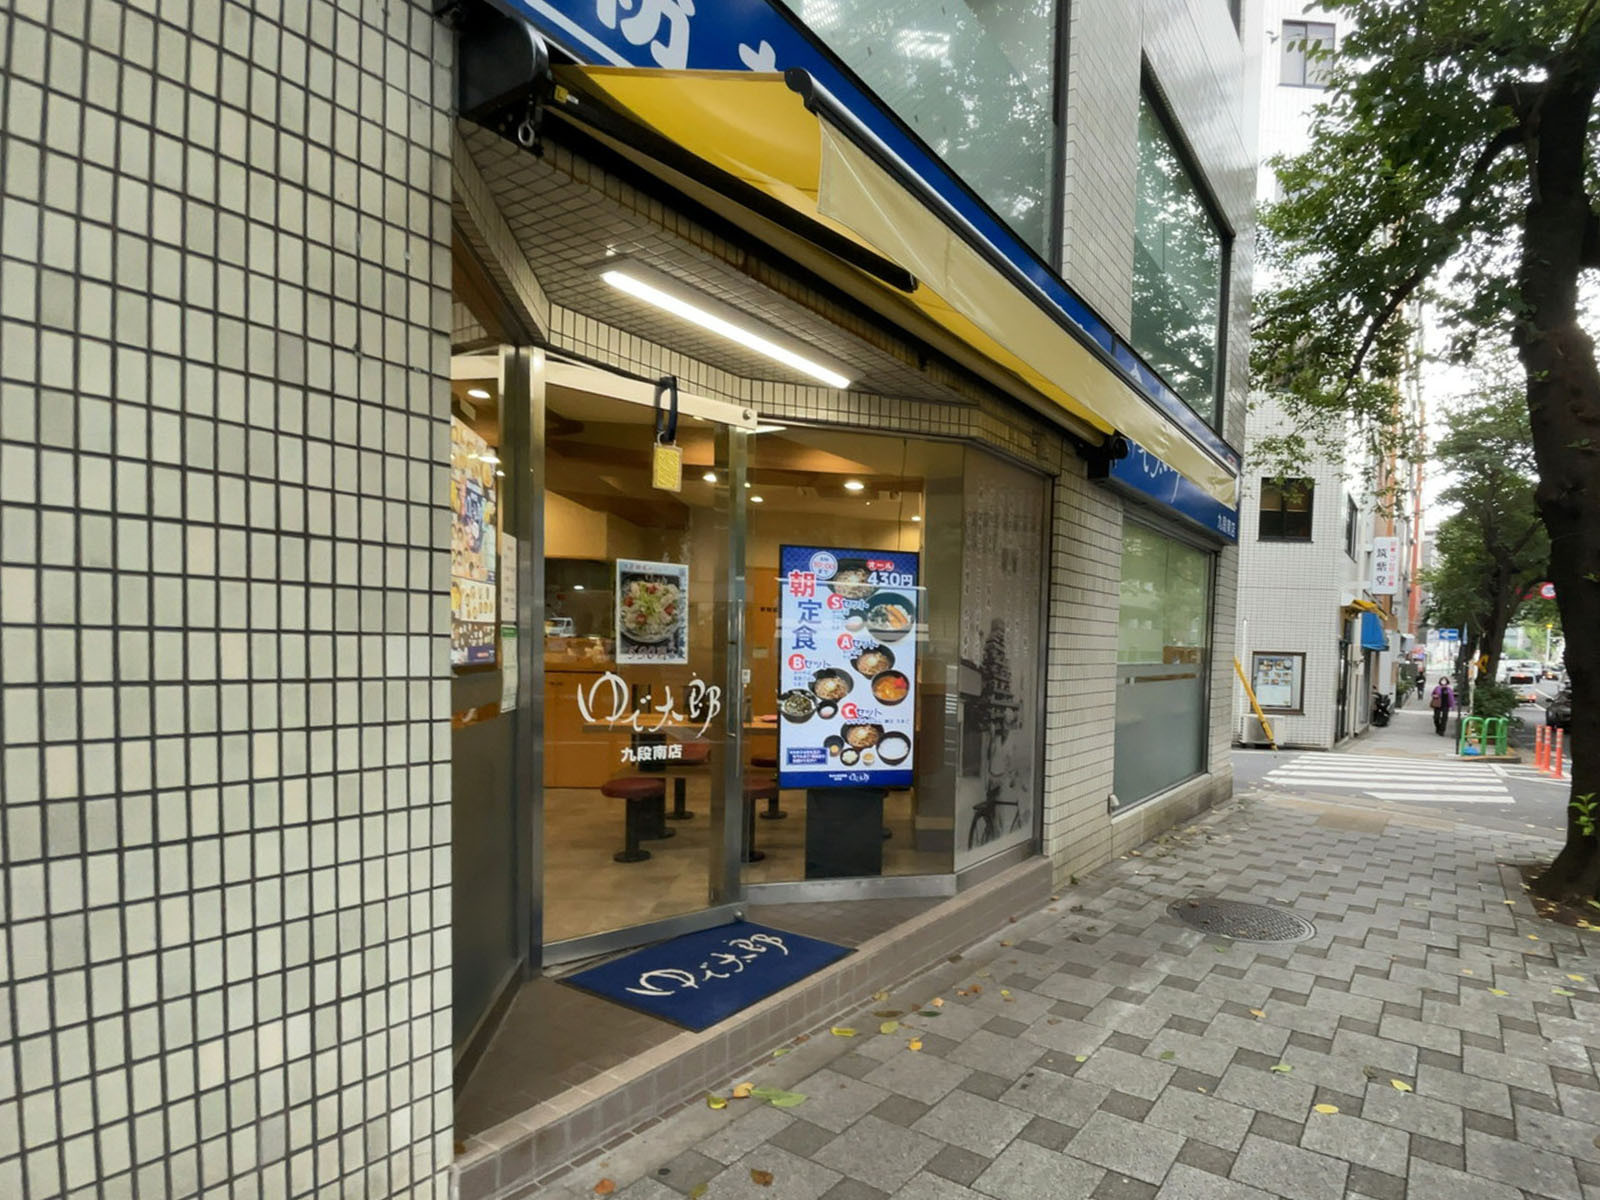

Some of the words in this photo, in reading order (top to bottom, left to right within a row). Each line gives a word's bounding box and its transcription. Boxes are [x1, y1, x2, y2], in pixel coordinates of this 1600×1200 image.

[867, 571, 914, 588] 430円
[620, 744, 683, 763] 九段南店
